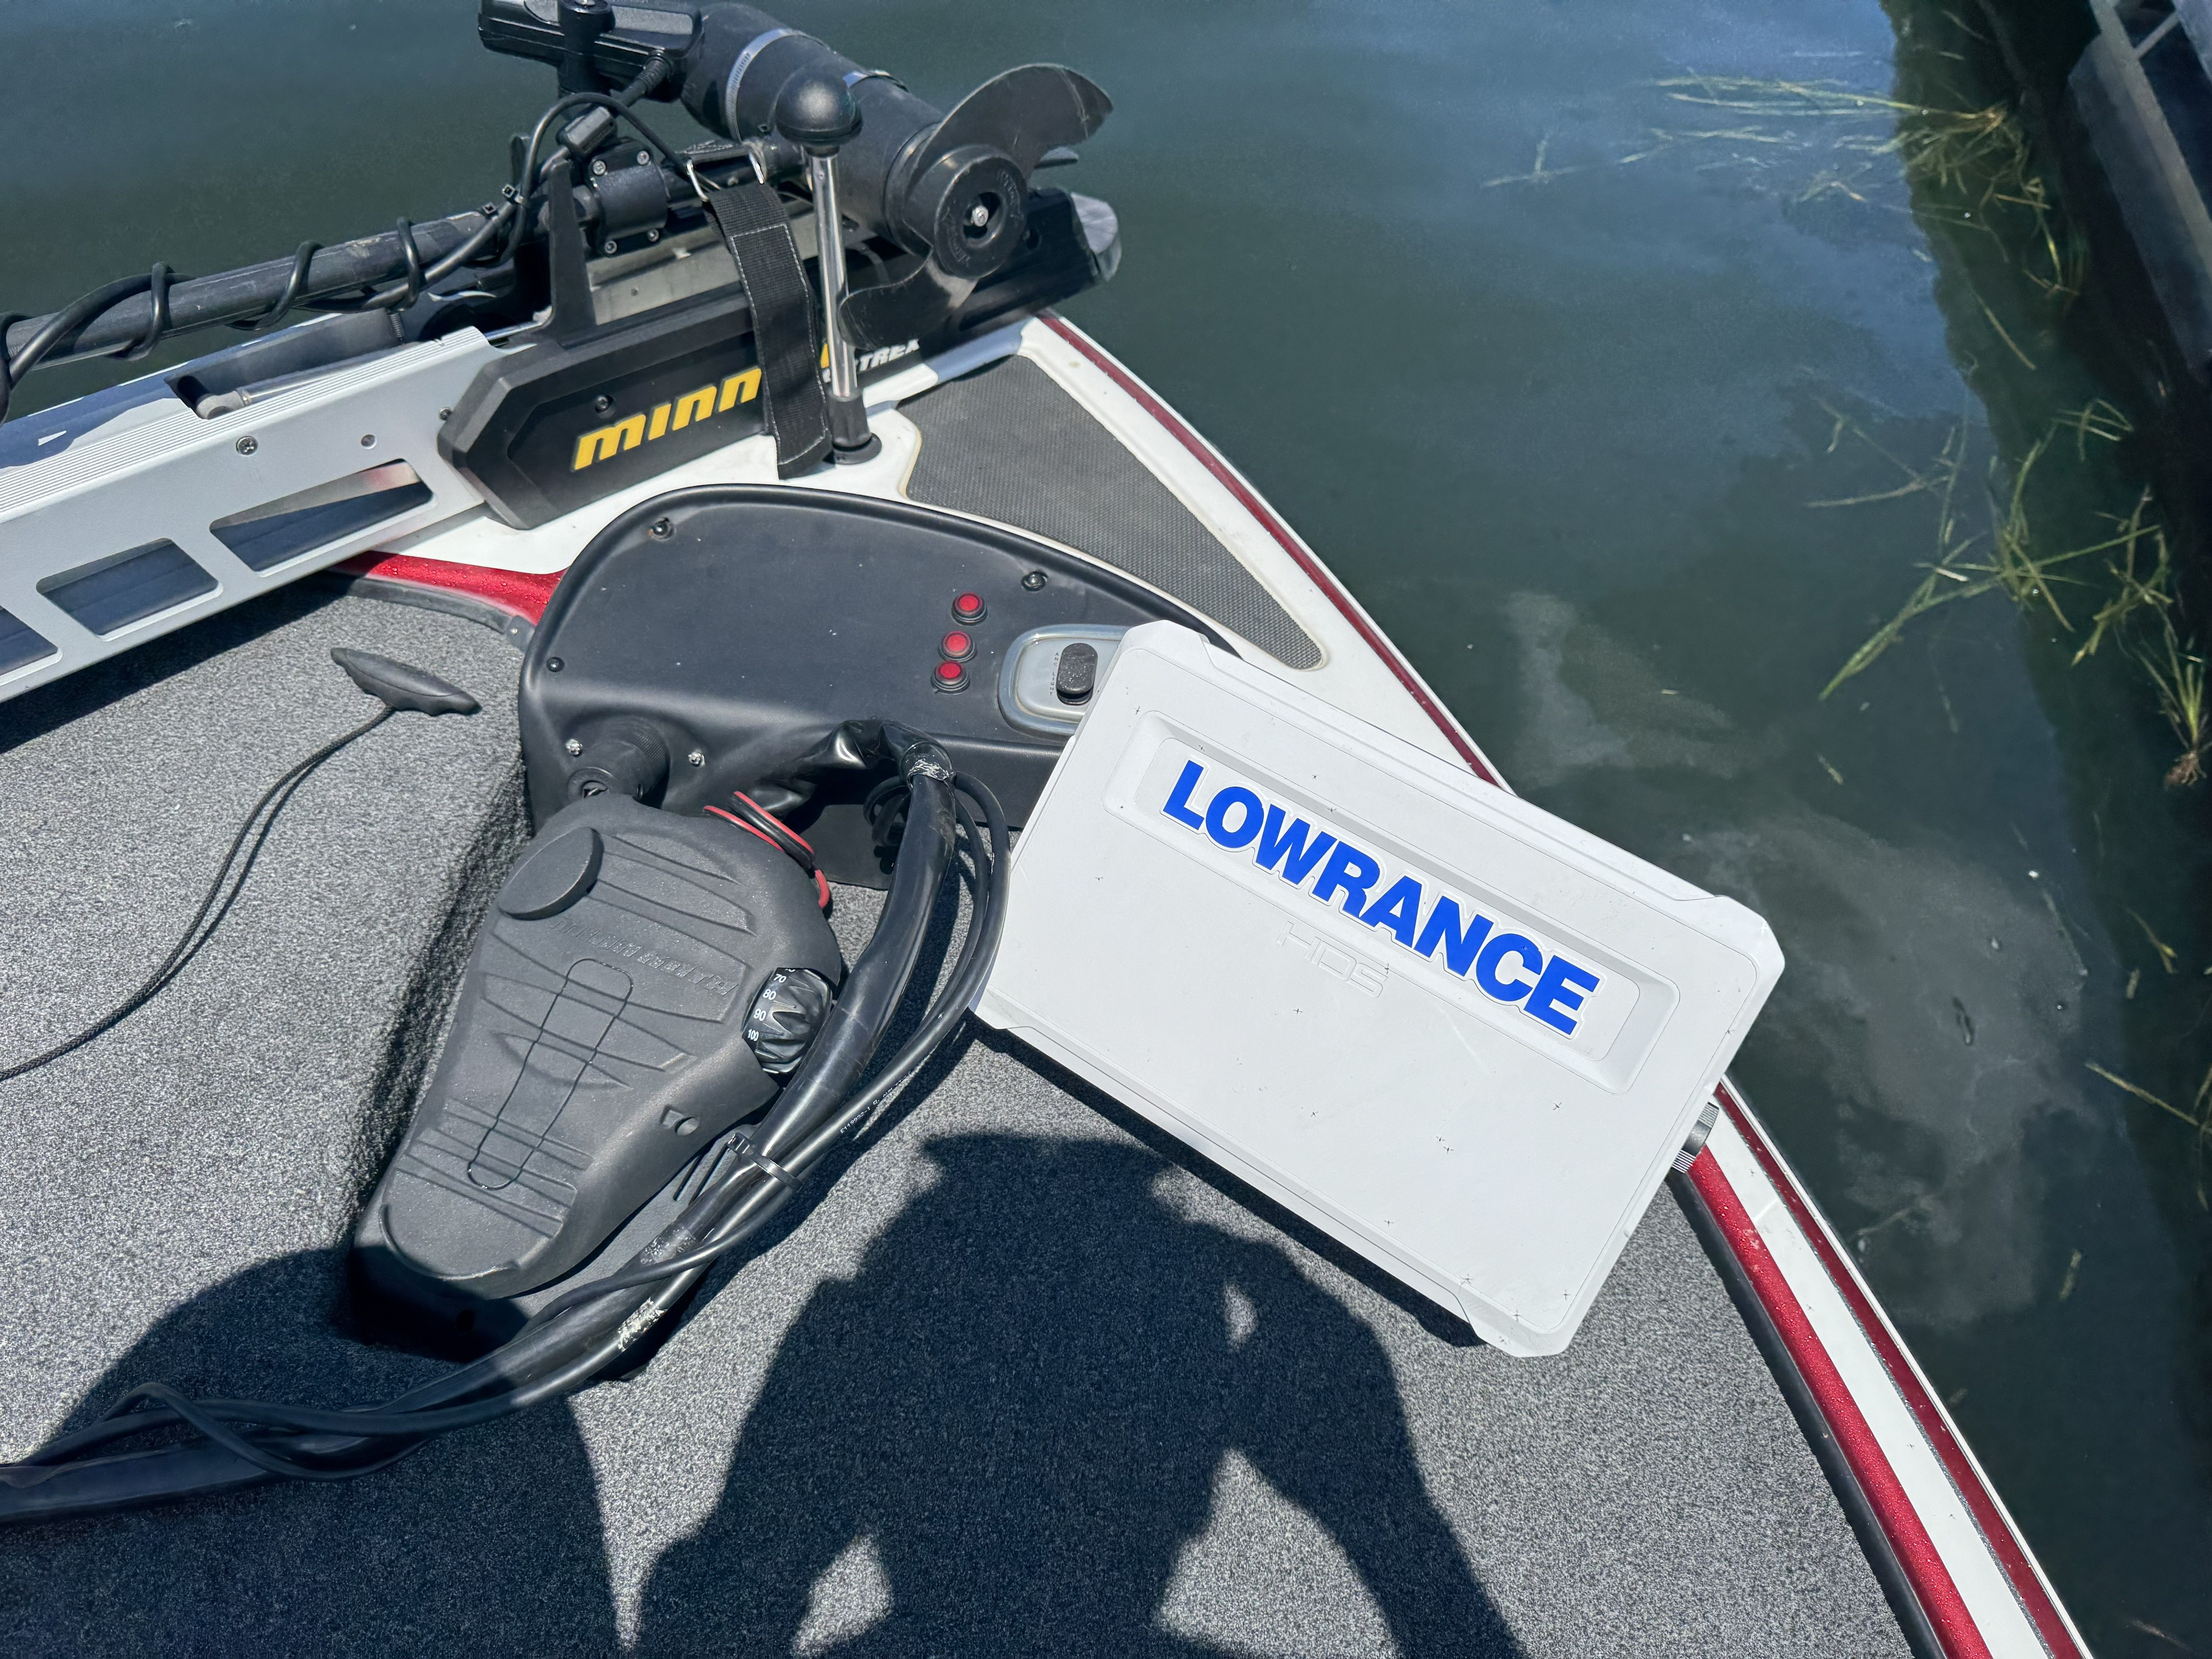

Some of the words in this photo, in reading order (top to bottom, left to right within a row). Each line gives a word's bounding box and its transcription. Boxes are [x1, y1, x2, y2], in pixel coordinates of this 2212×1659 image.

[1163, 760, 1600, 1036] LOWRANCE
[1277, 921, 1388, 998] HDS
[773, 974, 787, 983] 70
[763, 989, 776, 1000] 80
[754, 1008, 766, 1021] 90
[747, 1029, 759, 1041] 100
